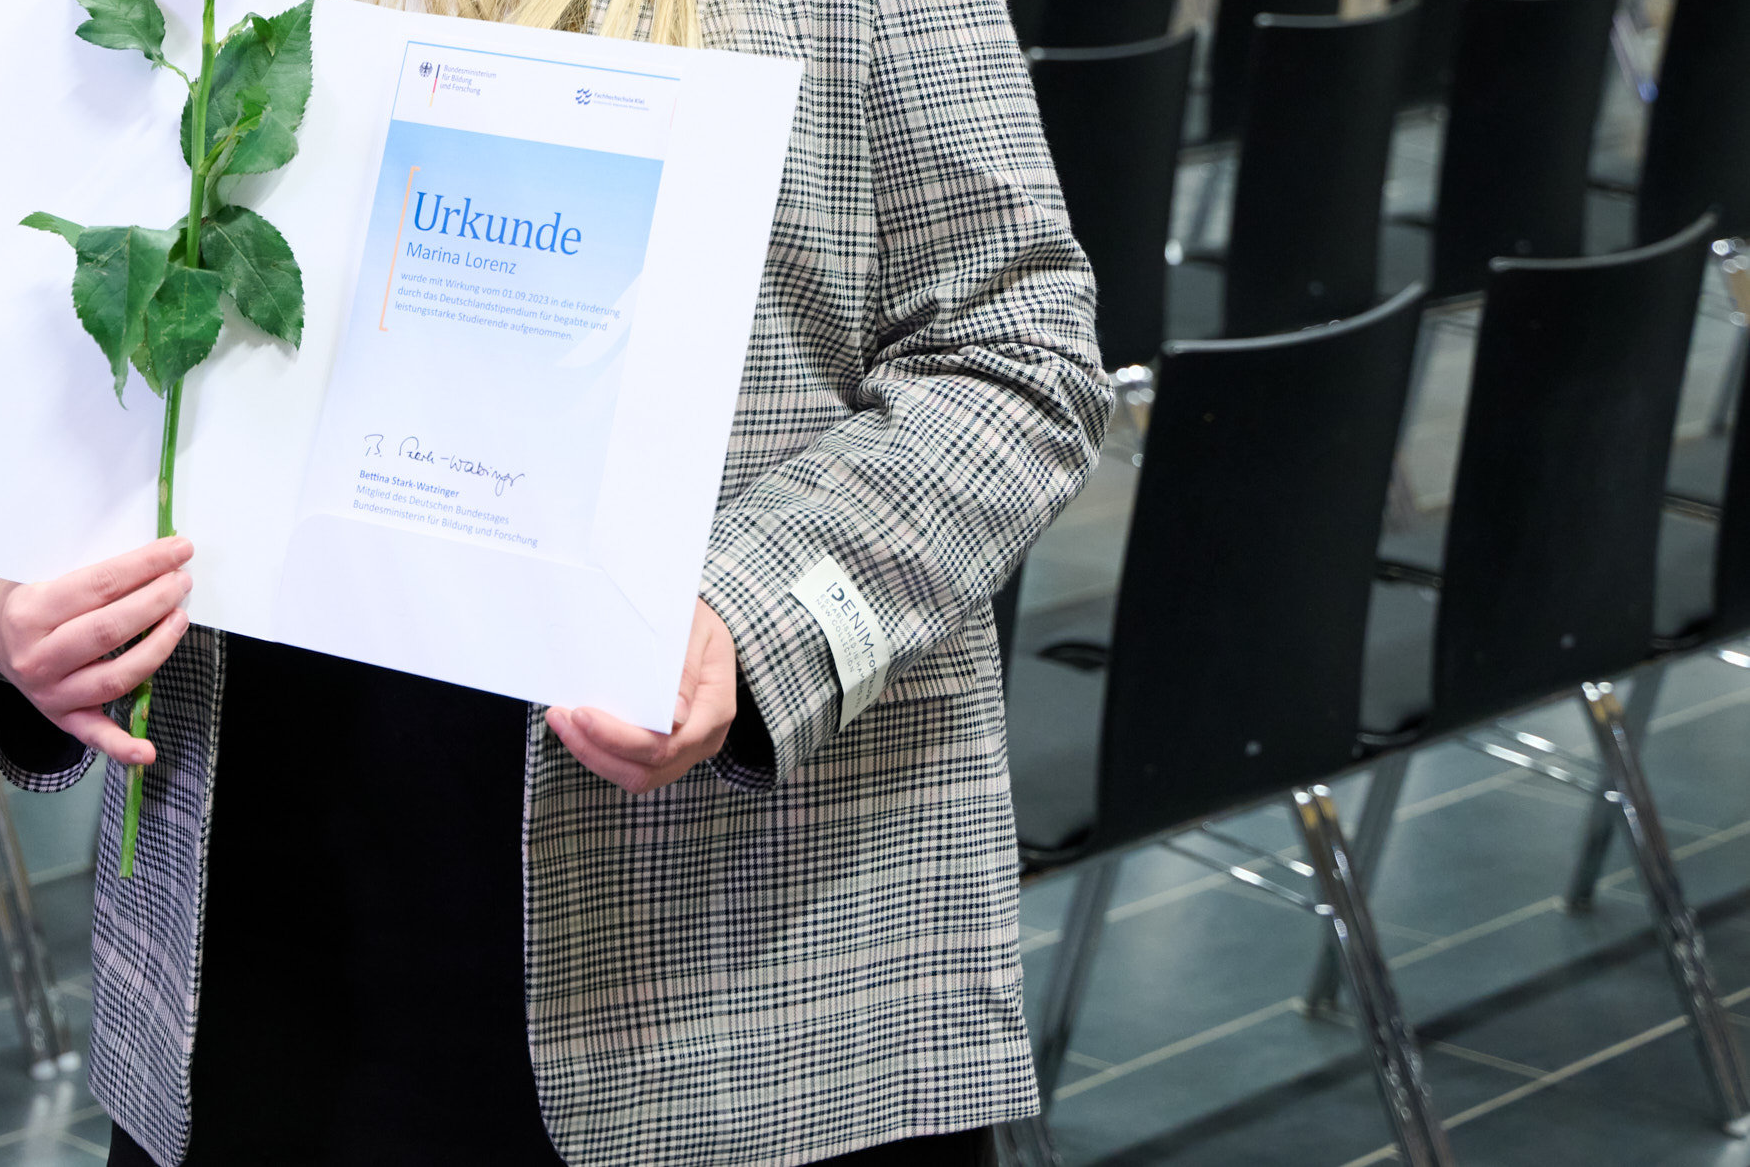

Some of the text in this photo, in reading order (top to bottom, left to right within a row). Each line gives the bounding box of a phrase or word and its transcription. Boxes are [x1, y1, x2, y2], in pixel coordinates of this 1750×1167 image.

[439, 82, 481, 96] und Forschung
[442, 73, 472, 85] für Bildung
[444, 65, 497, 79] Bundesministerium
[414, 191, 582, 256] Urkunde
[406, 241, 516, 275] Marina Lorenz
[398, 286, 608, 332] durch das Deutschlandstipendium für begabte und
[401, 272, 620, 319] wurde mit Wirkung vom 01.09.2023 in die Förderung
[395, 300, 574, 342] leistungsstarke Studierende aufgenommen.
[356, 484, 510, 525] Mitglied des Deutschen Bundestages
[360, 470, 460, 498] Bettina Stark-Watzinger
[353, 500, 538, 548] Bundesministerin für Bildung und Forschung
[816, 598, 854, 672] NEW COLLECTION
[826, 582, 874, 654] DENIM
